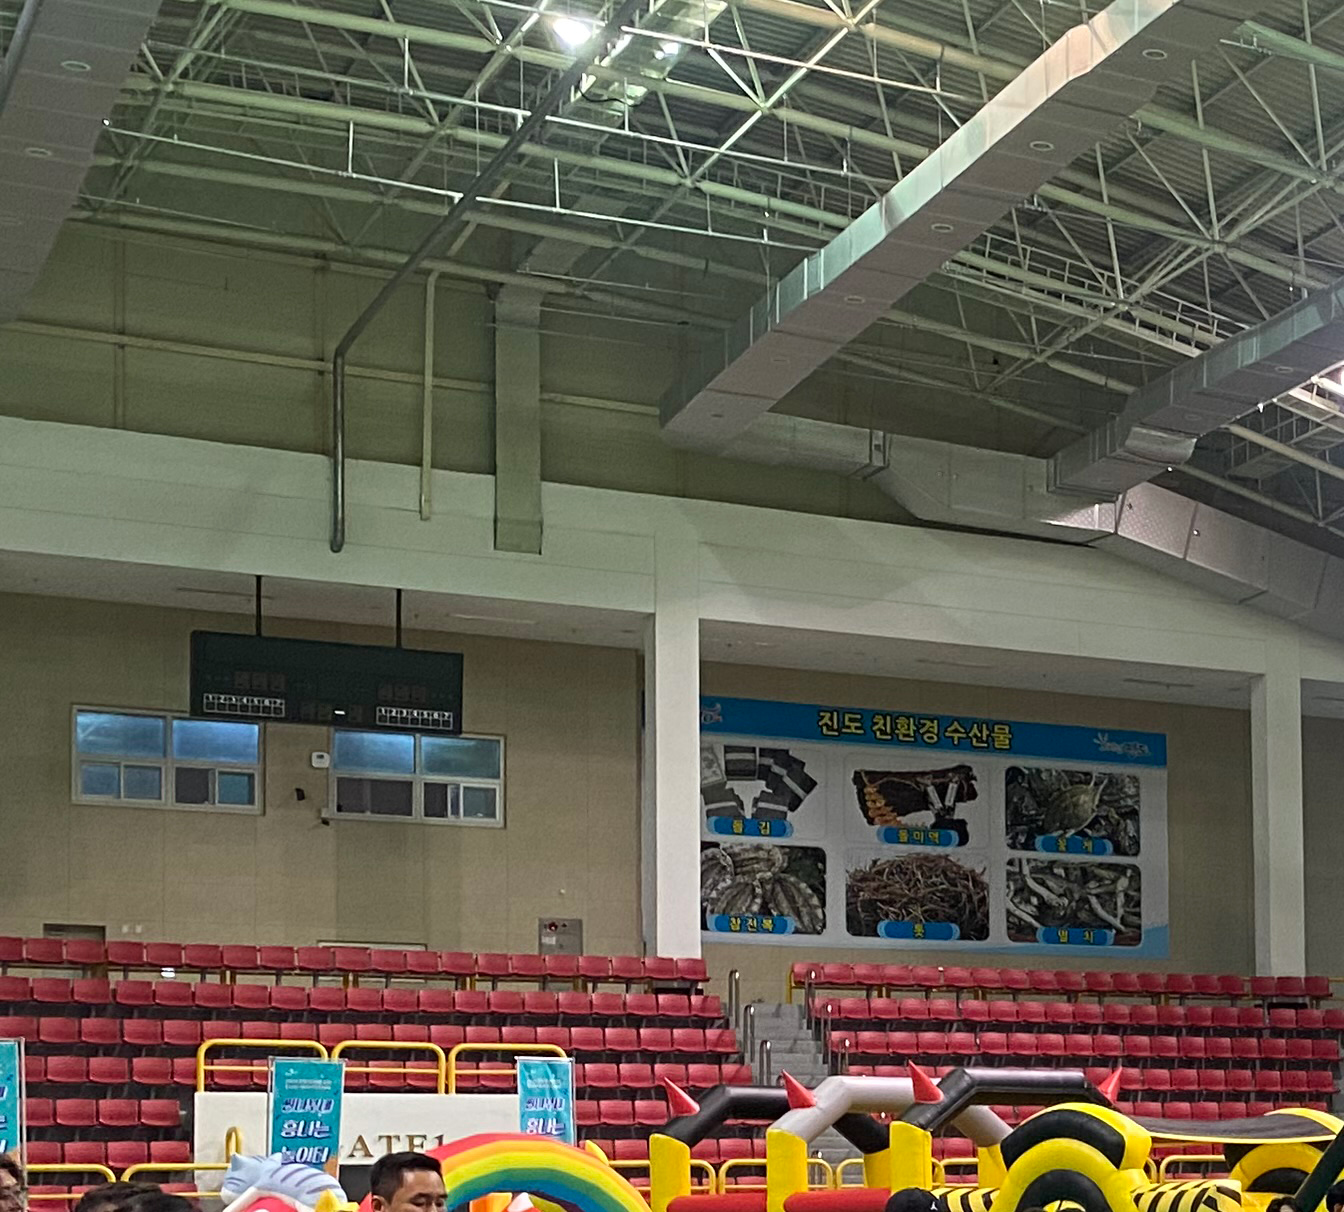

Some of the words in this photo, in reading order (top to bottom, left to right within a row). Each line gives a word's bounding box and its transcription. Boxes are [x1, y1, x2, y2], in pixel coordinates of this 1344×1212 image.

[818, 711, 865, 736] 진도
[872, 715, 940, 744] 친환경
[944, 720, 1013, 750] 수산물
[280, 1119, 331, 1138] 흥나는
[341, 1134, 444, 1158] ATE1
